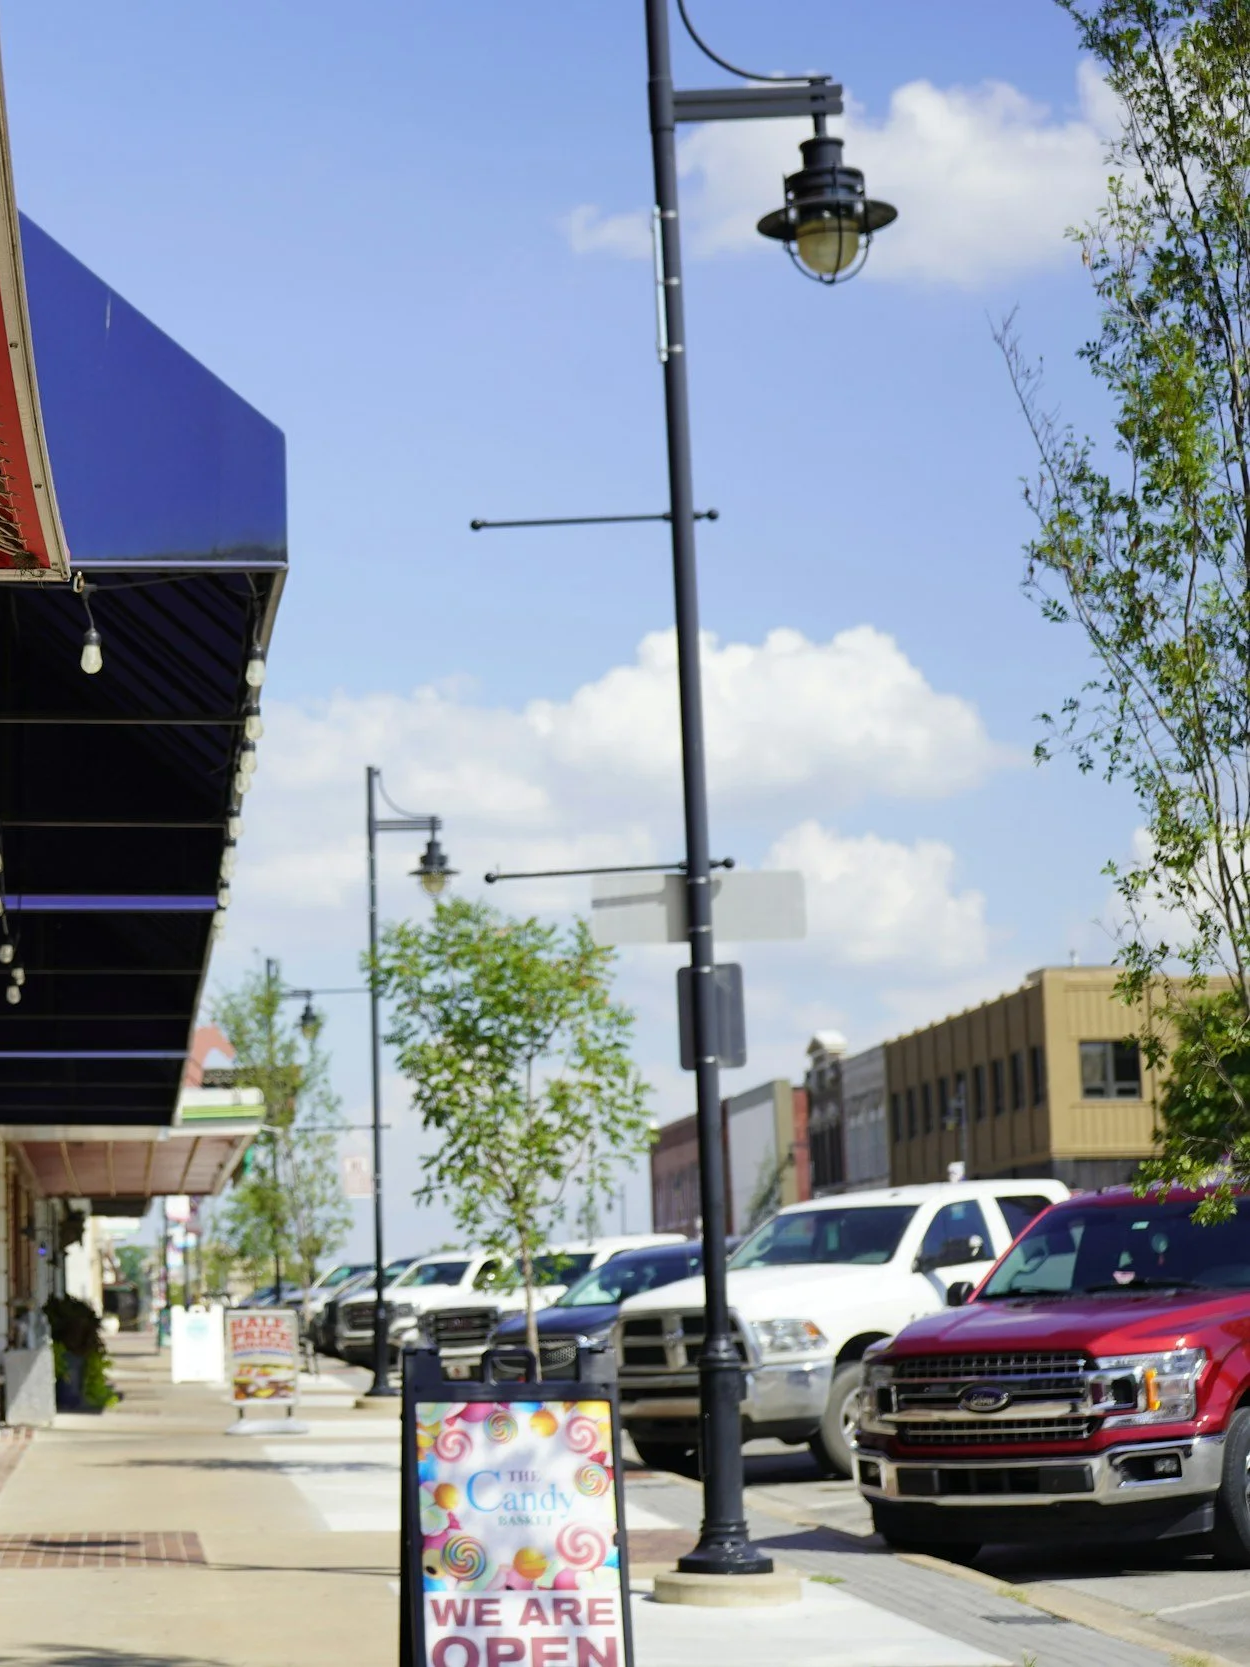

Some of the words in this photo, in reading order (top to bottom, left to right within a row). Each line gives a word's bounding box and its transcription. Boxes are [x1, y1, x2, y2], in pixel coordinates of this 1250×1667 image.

[507, 1469, 542, 1483] THE
[465, 1469, 576, 1519] Candy
[430, 1597, 503, 1627] WE
[518, 1597, 616, 1627] ARE
[432, 1635, 619, 1667] OPEN
